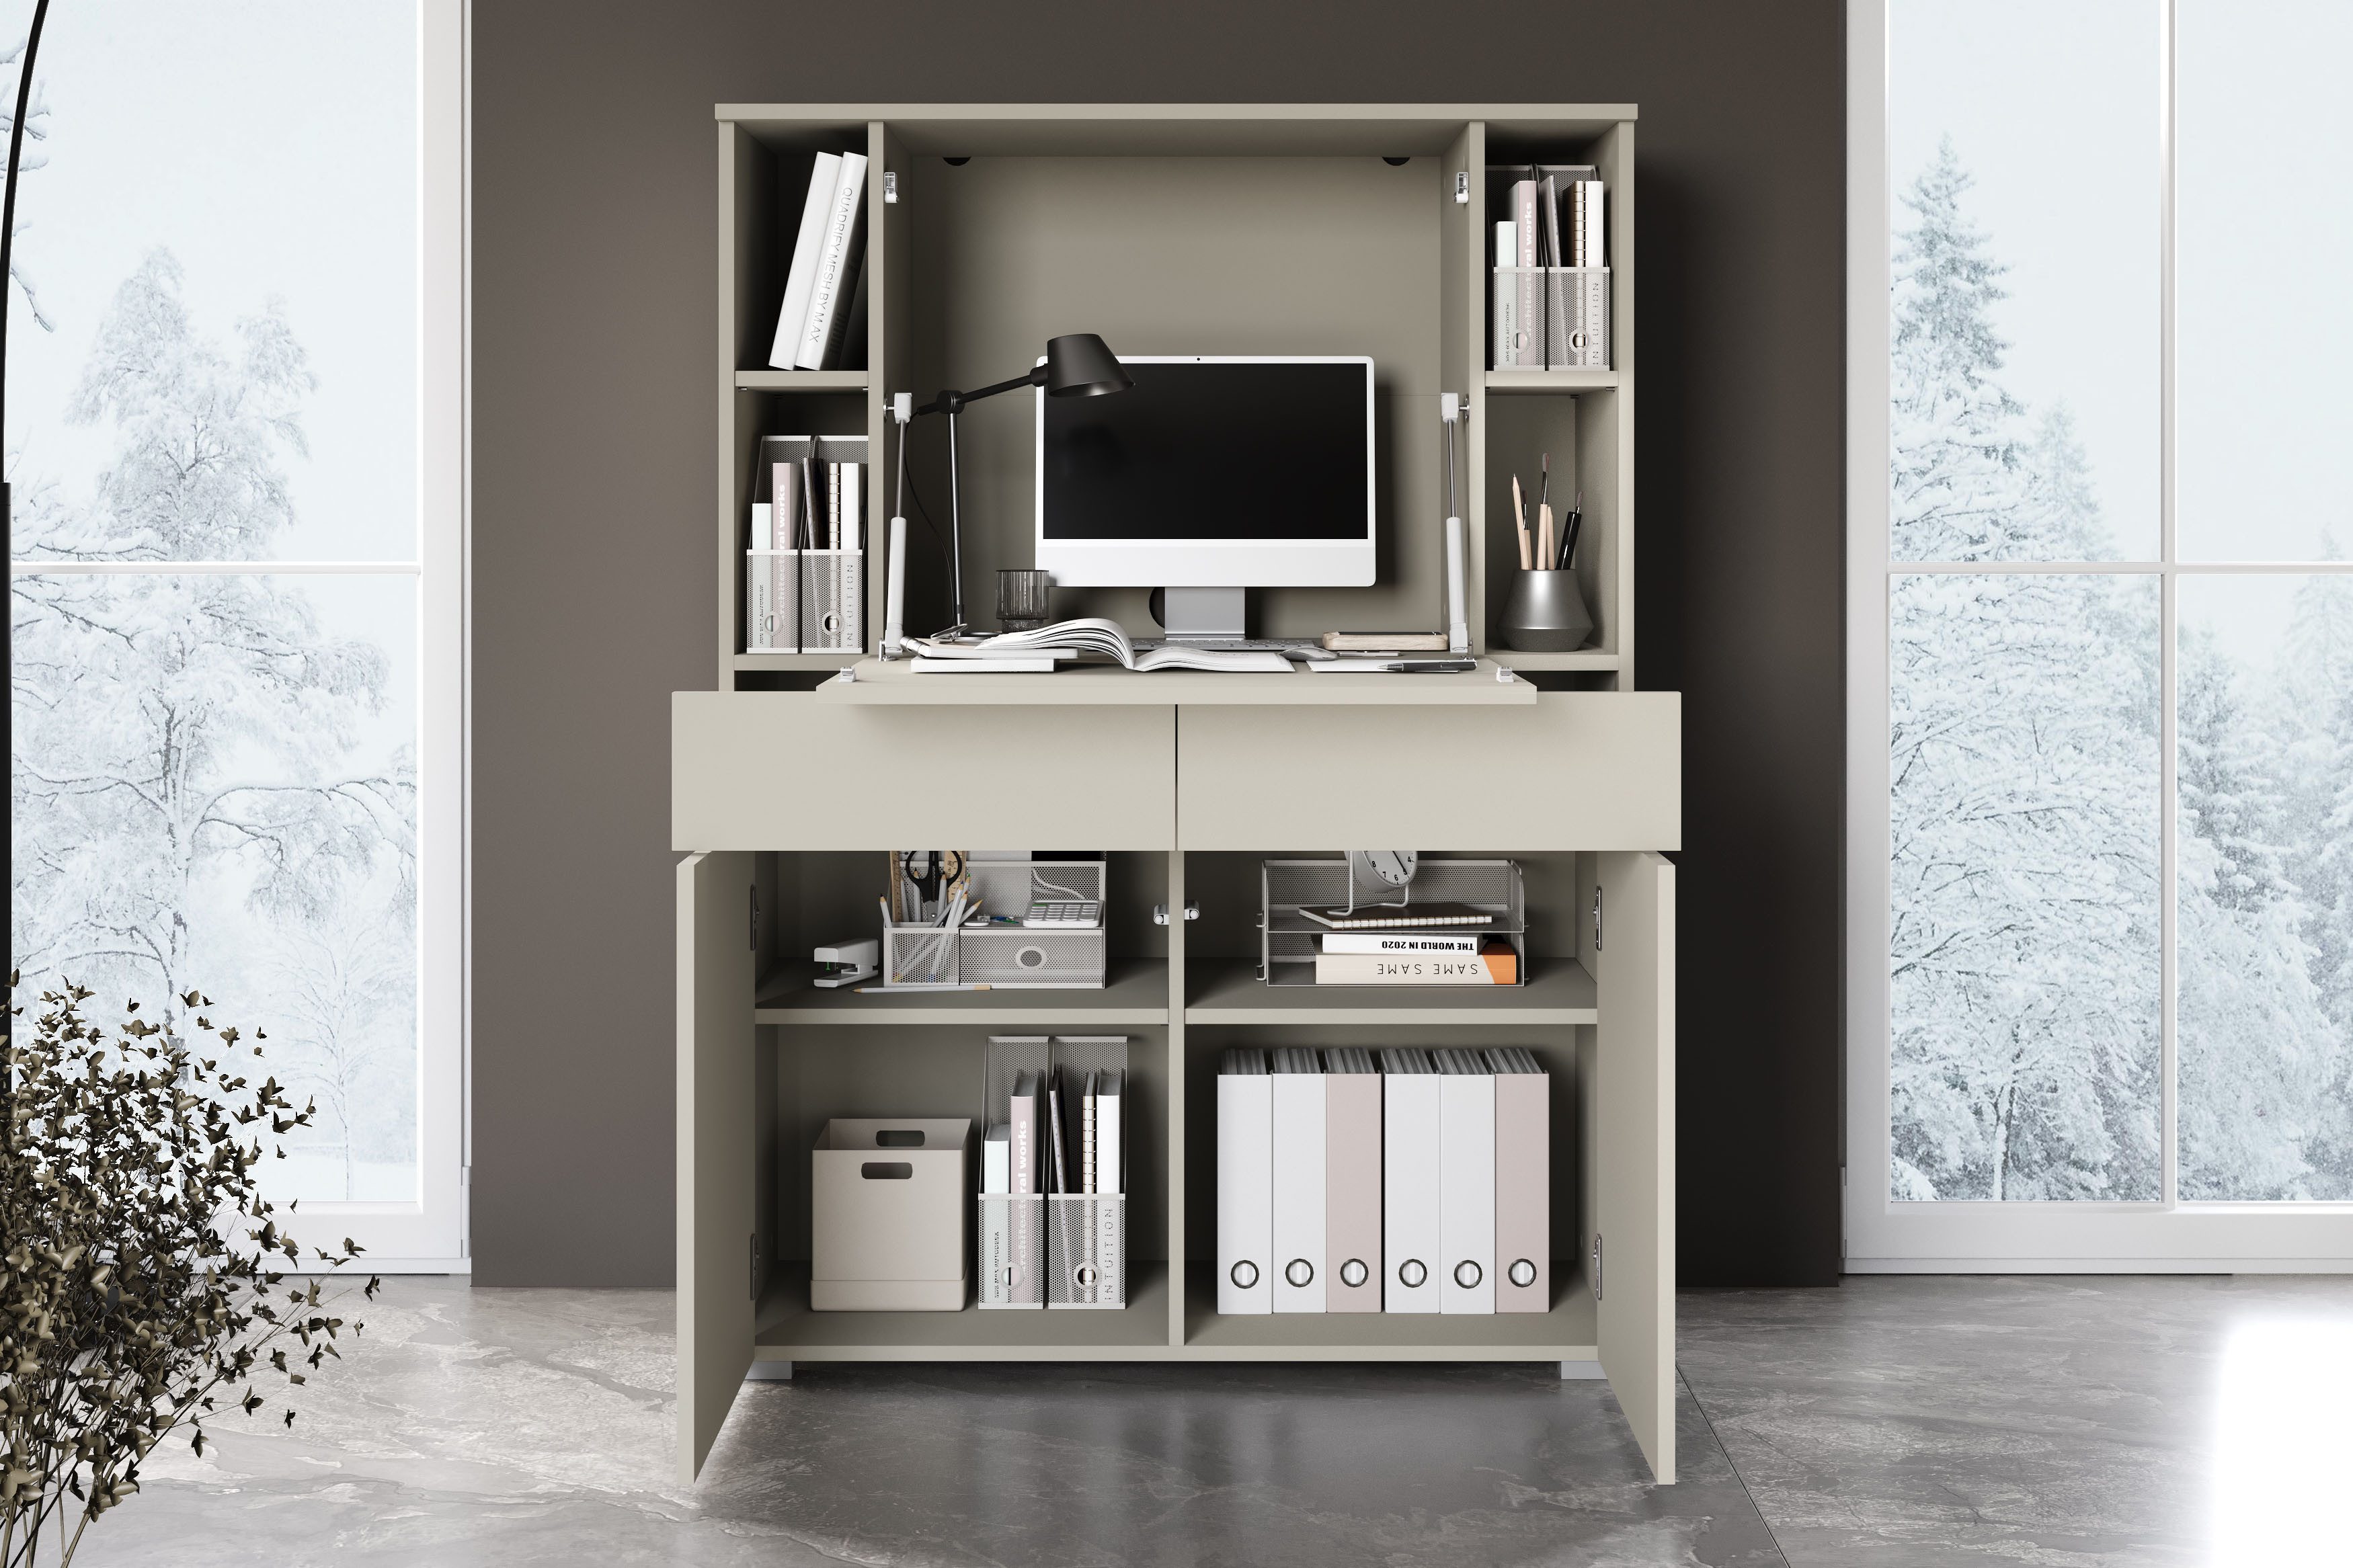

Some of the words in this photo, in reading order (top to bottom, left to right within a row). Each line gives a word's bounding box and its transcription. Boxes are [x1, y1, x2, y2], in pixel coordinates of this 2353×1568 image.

[831, 187, 852, 251] QUADRIFY
[821, 253, 838, 290] MESH
[816, 293, 829, 311] BY
[1382, 941, 1406, 949] 2020
[1421, 942, 1455, 950] WORLD
[1457, 942, 1474, 950] THE
[1377, 964, 1422, 975] SAME
[1433, 964, 1478, 975] SAME
[1019, 1120, 1027, 1169] works
[1105, 1209, 1113, 1300] INTUITION
